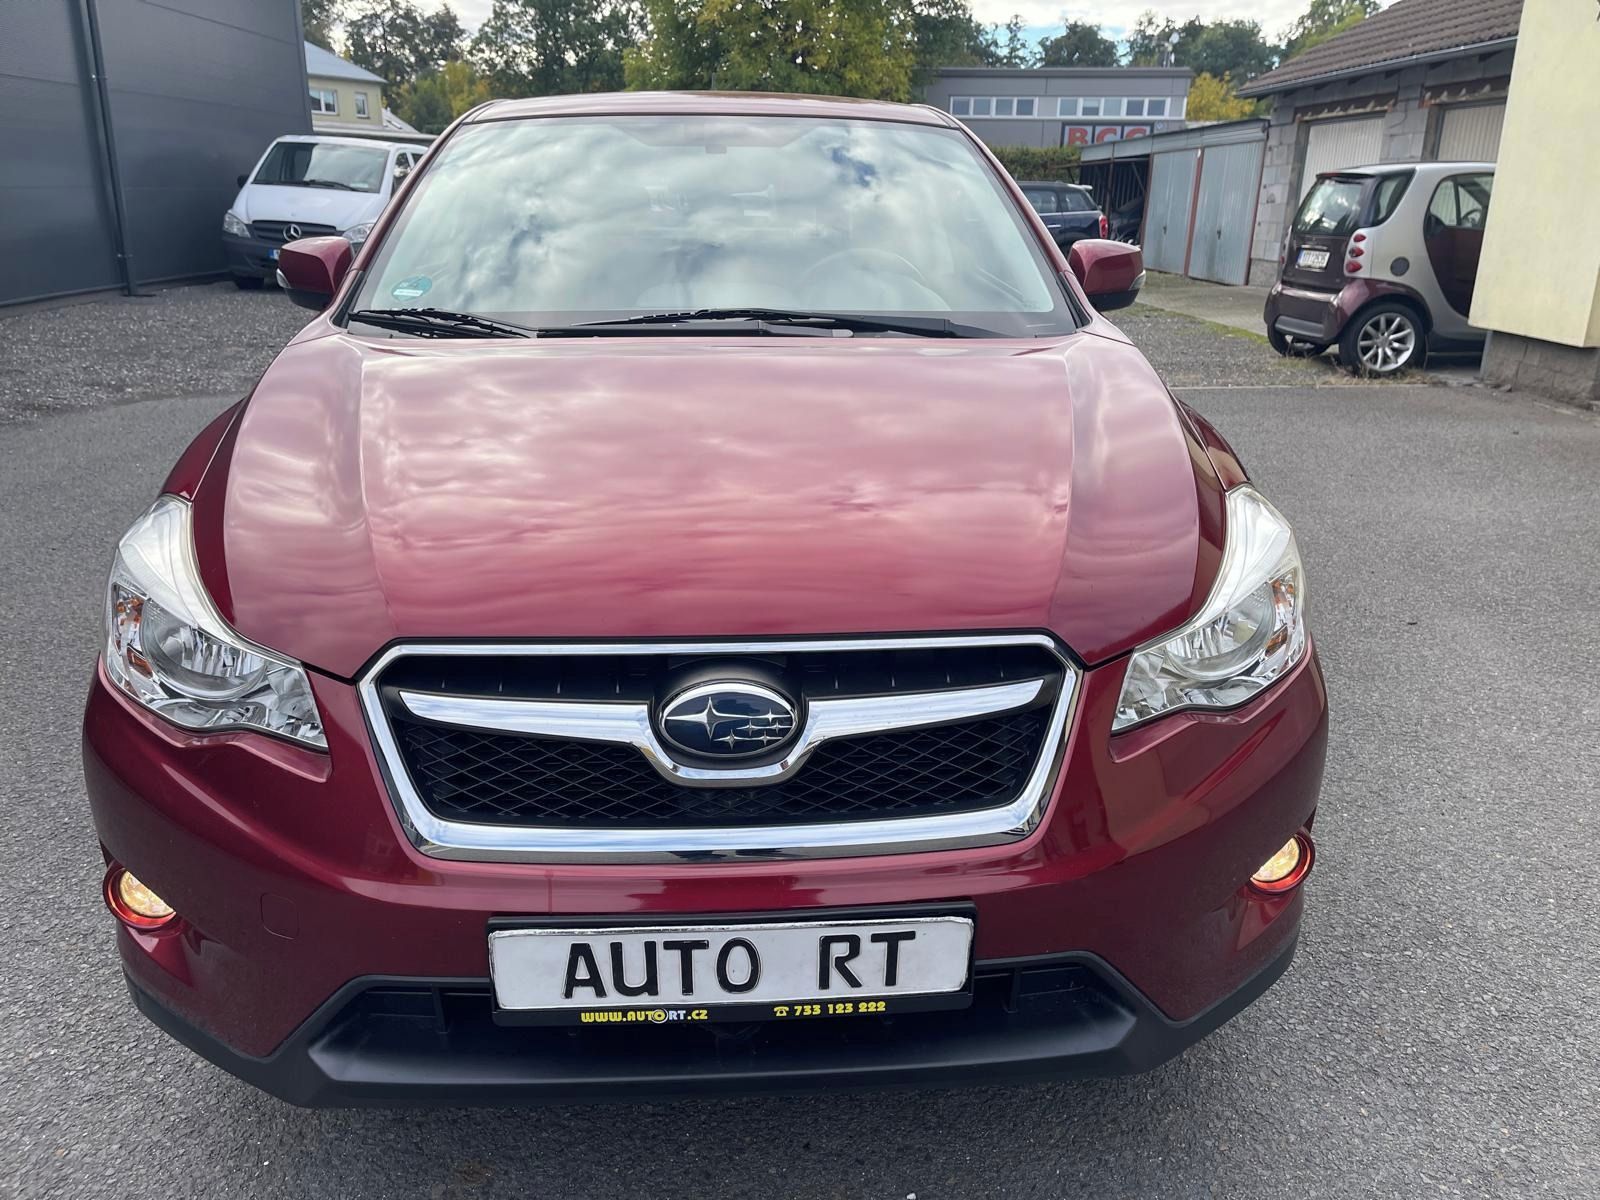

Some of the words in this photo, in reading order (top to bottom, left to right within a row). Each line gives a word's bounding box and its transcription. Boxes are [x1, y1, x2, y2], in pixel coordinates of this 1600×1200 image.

[562, 937, 762, 999] AUTO
[818, 930, 916, 990] RT
[794, 1005, 821, 1016] 733
[827, 1003, 854, 1014] 123
[858, 1001, 886, 1012] 222
